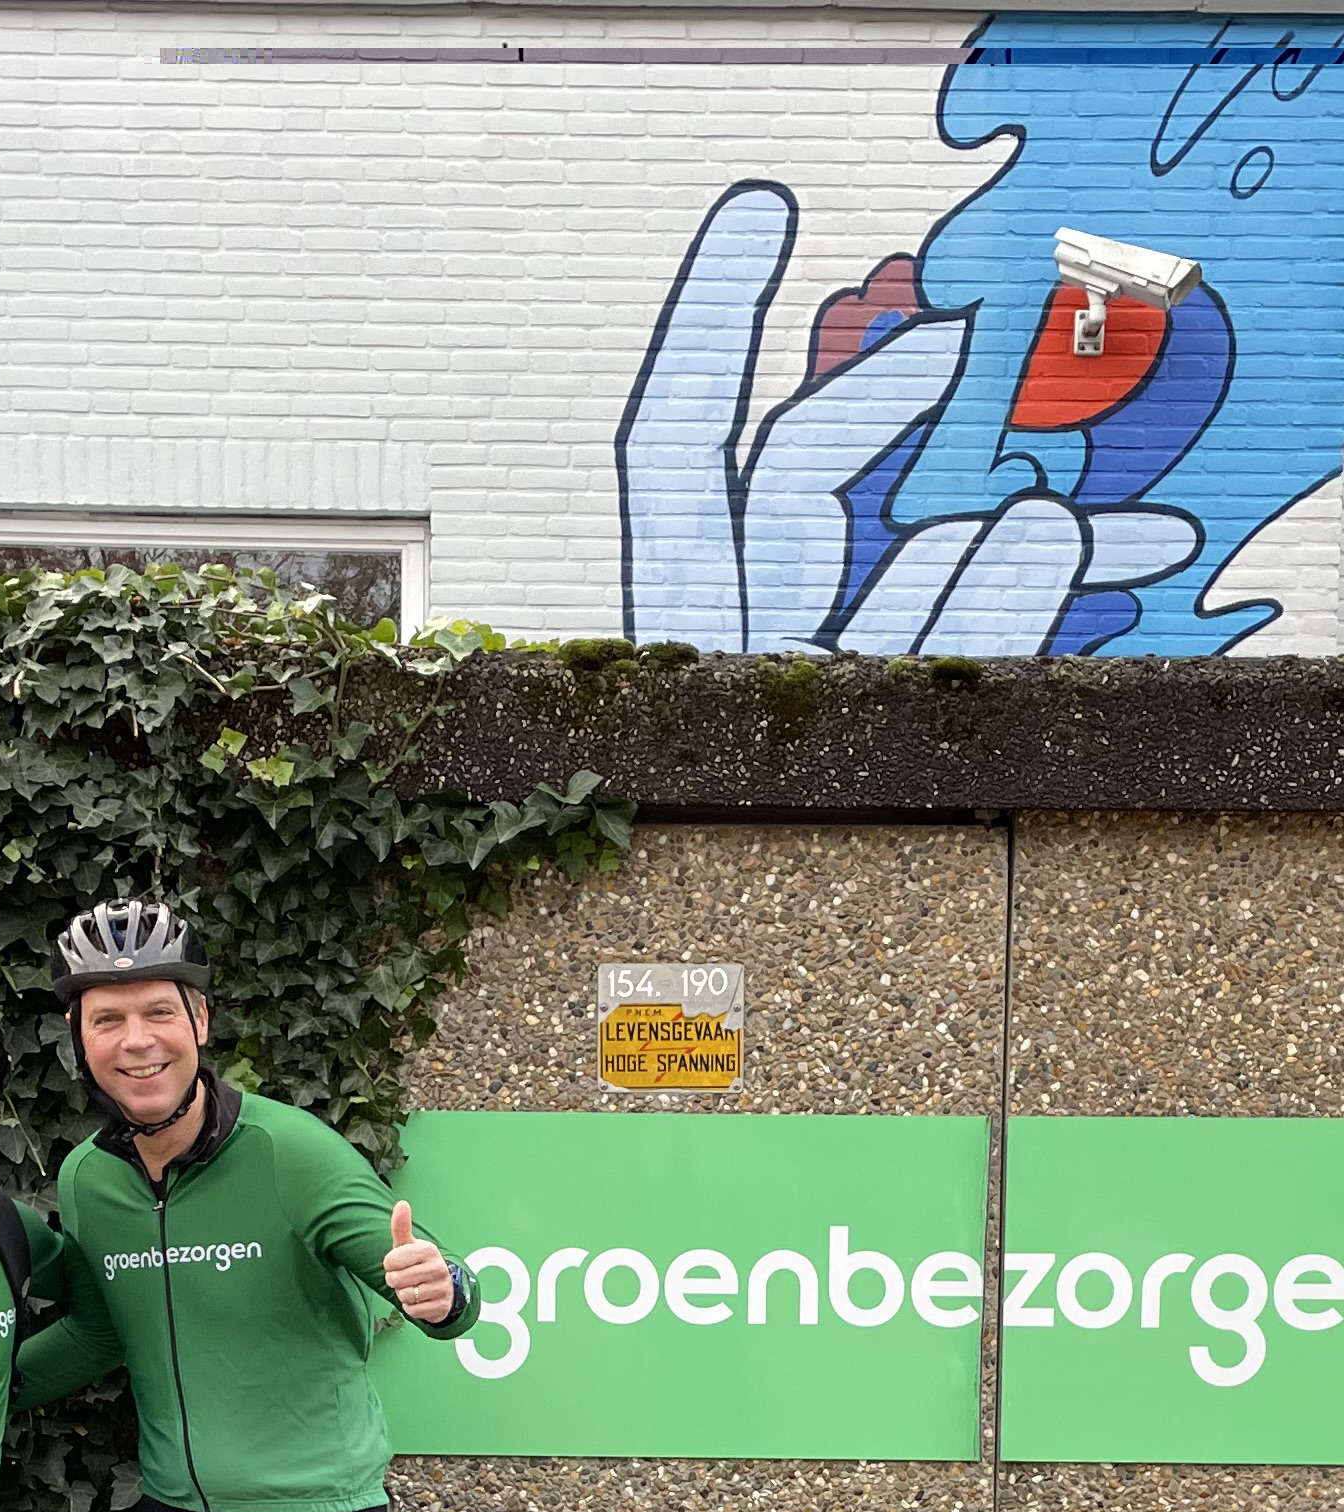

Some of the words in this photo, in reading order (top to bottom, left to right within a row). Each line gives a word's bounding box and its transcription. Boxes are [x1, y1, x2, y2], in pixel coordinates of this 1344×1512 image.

[681, 967, 728, 998] 190
[605, 1053, 648, 1072] HOGE
[657, 1053, 736, 1073] SPANNING
[103, 1241, 263, 1281] groenbezorgen
